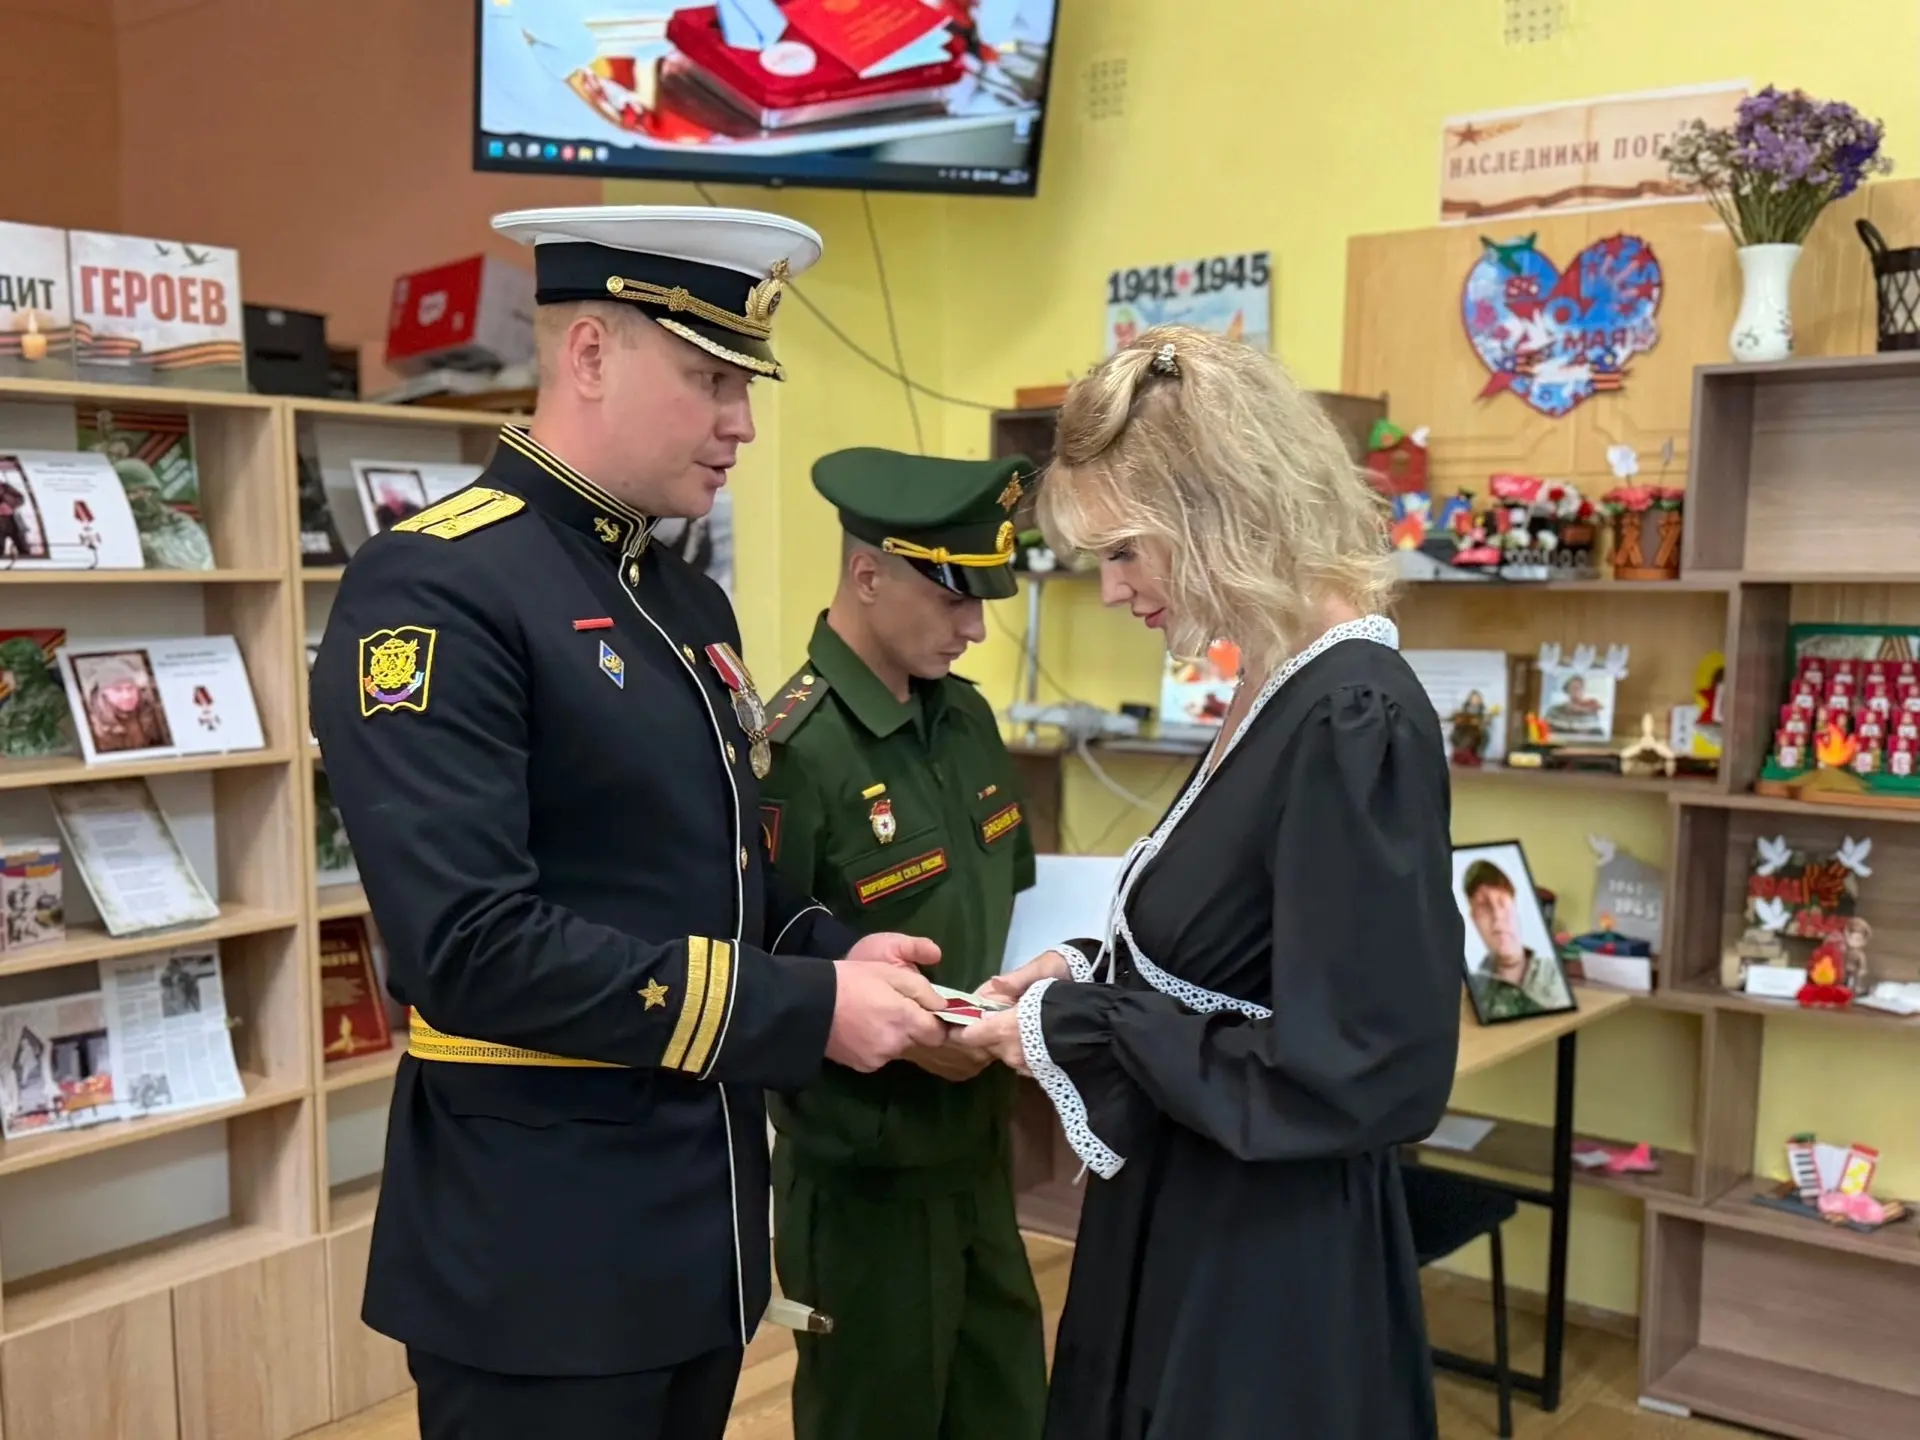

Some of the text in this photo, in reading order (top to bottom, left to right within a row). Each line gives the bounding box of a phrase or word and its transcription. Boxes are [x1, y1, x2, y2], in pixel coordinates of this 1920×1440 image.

[1449, 140, 1600, 180] НАСЛЕДНИКИ
[80, 265, 227, 326] ГЕРОЕВ
[1107, 252, 1270, 304] 1941 1945
